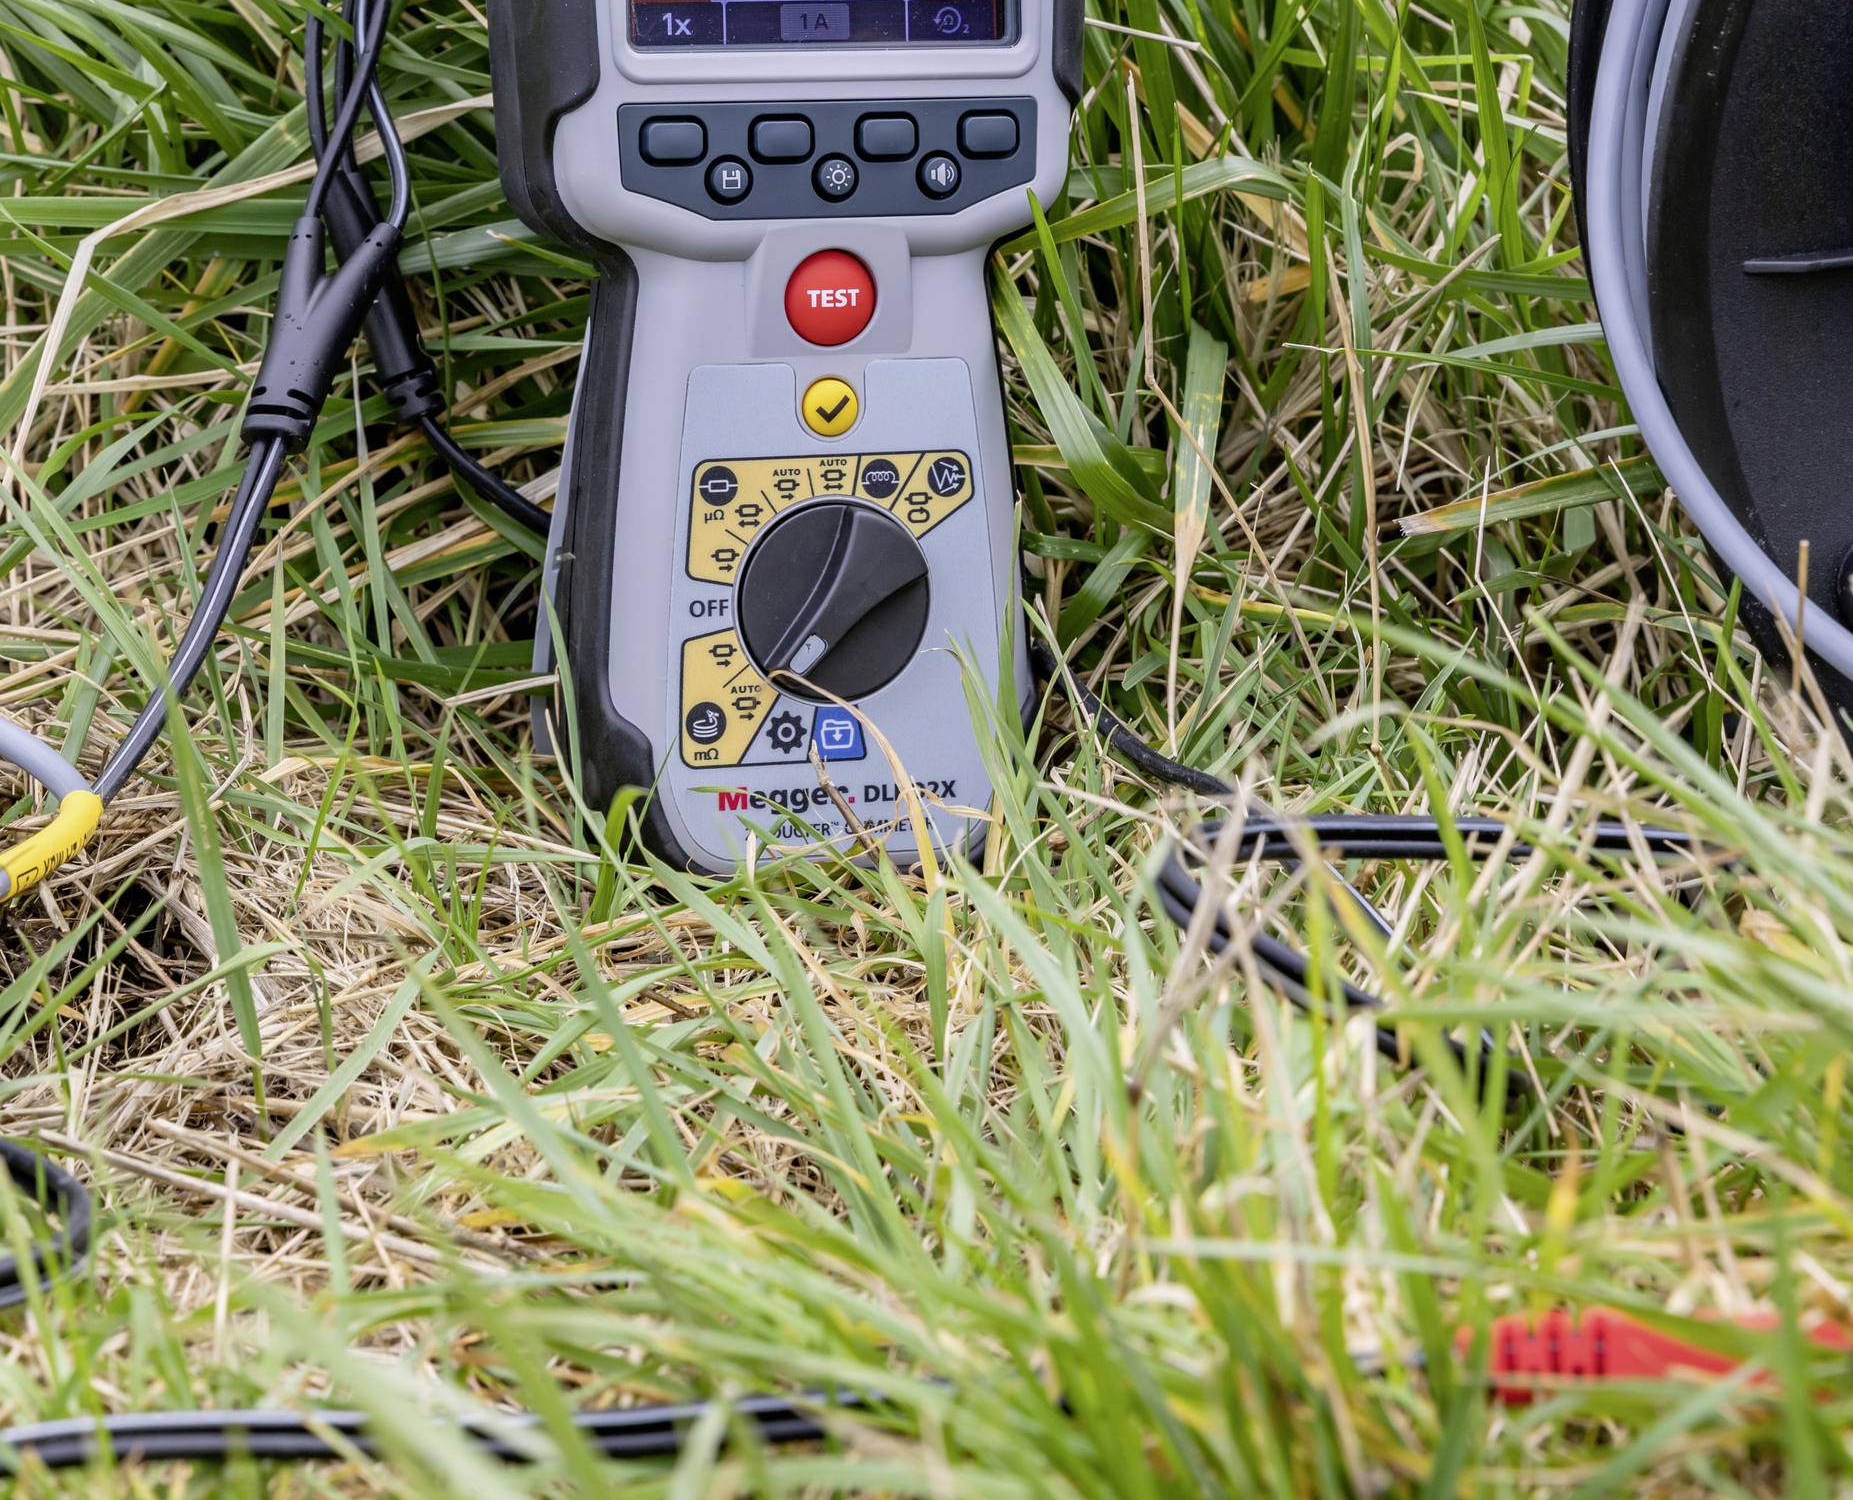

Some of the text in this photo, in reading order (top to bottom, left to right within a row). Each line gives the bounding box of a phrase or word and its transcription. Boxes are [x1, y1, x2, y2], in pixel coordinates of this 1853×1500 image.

[662, 12, 692, 36] 1x
[807, 289, 859, 308] TEST
[819, 459, 847, 467] AUTO
[773, 469, 801, 477] AUTO
[689, 599, 729, 618] OFF
[730, 685, 762, 694] AUTO
[694, 748, 719, 761] mΩ
